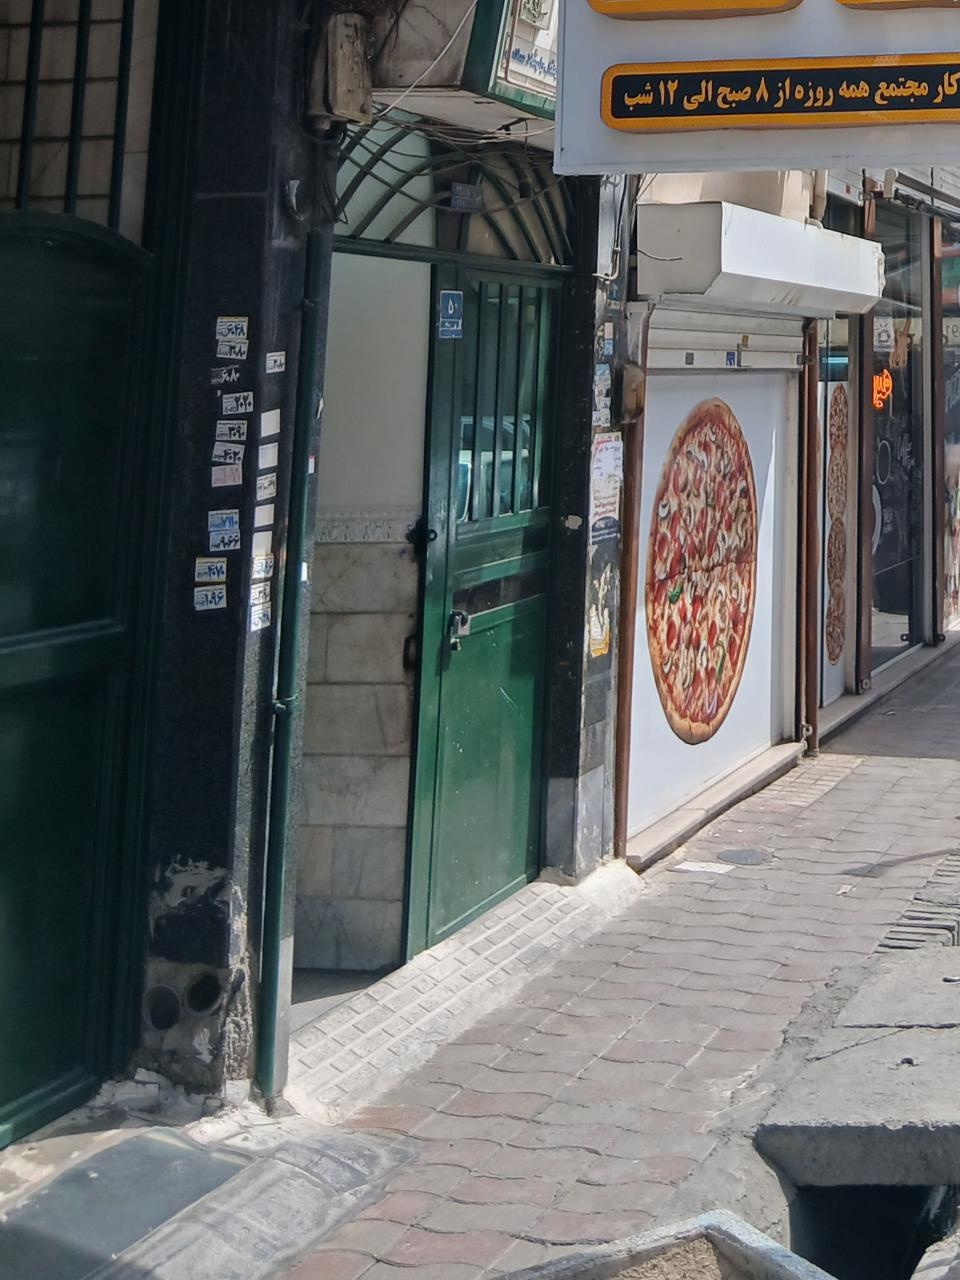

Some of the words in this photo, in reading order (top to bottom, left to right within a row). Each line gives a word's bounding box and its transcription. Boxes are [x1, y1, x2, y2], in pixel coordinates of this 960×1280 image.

[624, 82, 653, 108] شب
[659, 78, 678, 104] ۱۲
[683, 78, 712, 110] الی
[717, 85, 751, 108] صبح
[756, 78, 768, 101] ۸
[775, 77, 790, 108] از
[795, 83, 833, 107] روزه
[839, 79, 869, 98] همه
[875, 77, 928, 104] مجتمع
[933, 70, 960, 103] کار
